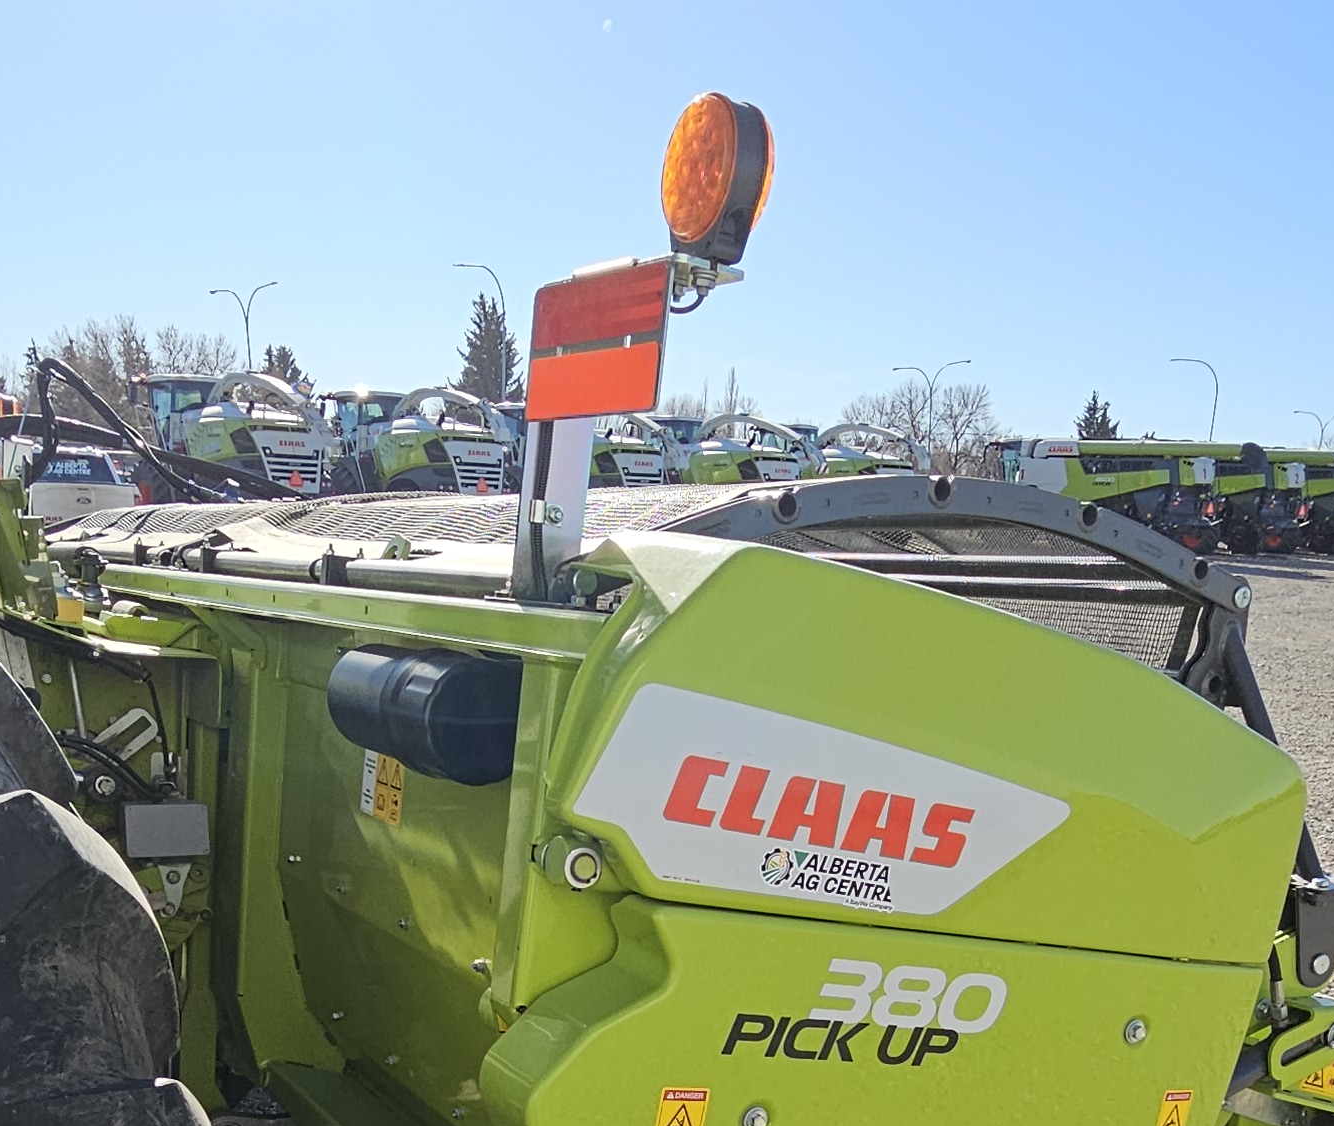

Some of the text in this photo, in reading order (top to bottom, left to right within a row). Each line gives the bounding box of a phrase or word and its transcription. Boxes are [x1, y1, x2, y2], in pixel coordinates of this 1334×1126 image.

[279, 440, 306, 448] CLAAS
[1048, 445, 1073, 453] CLAAS
[468, 449, 491, 457] CLAAS
[55, 461, 88, 469] ALBERTA
[663, 754, 975, 868] CLAAS
[803, 854, 890, 883] ALBERTA
[790, 872, 820, 891] AG
[869, 901, 893, 912] Company
[809, 958, 1007, 1034] 380
[721, 1013, 959, 1068] PICK UP
[674, 1091, 704, 1100] DANGER
